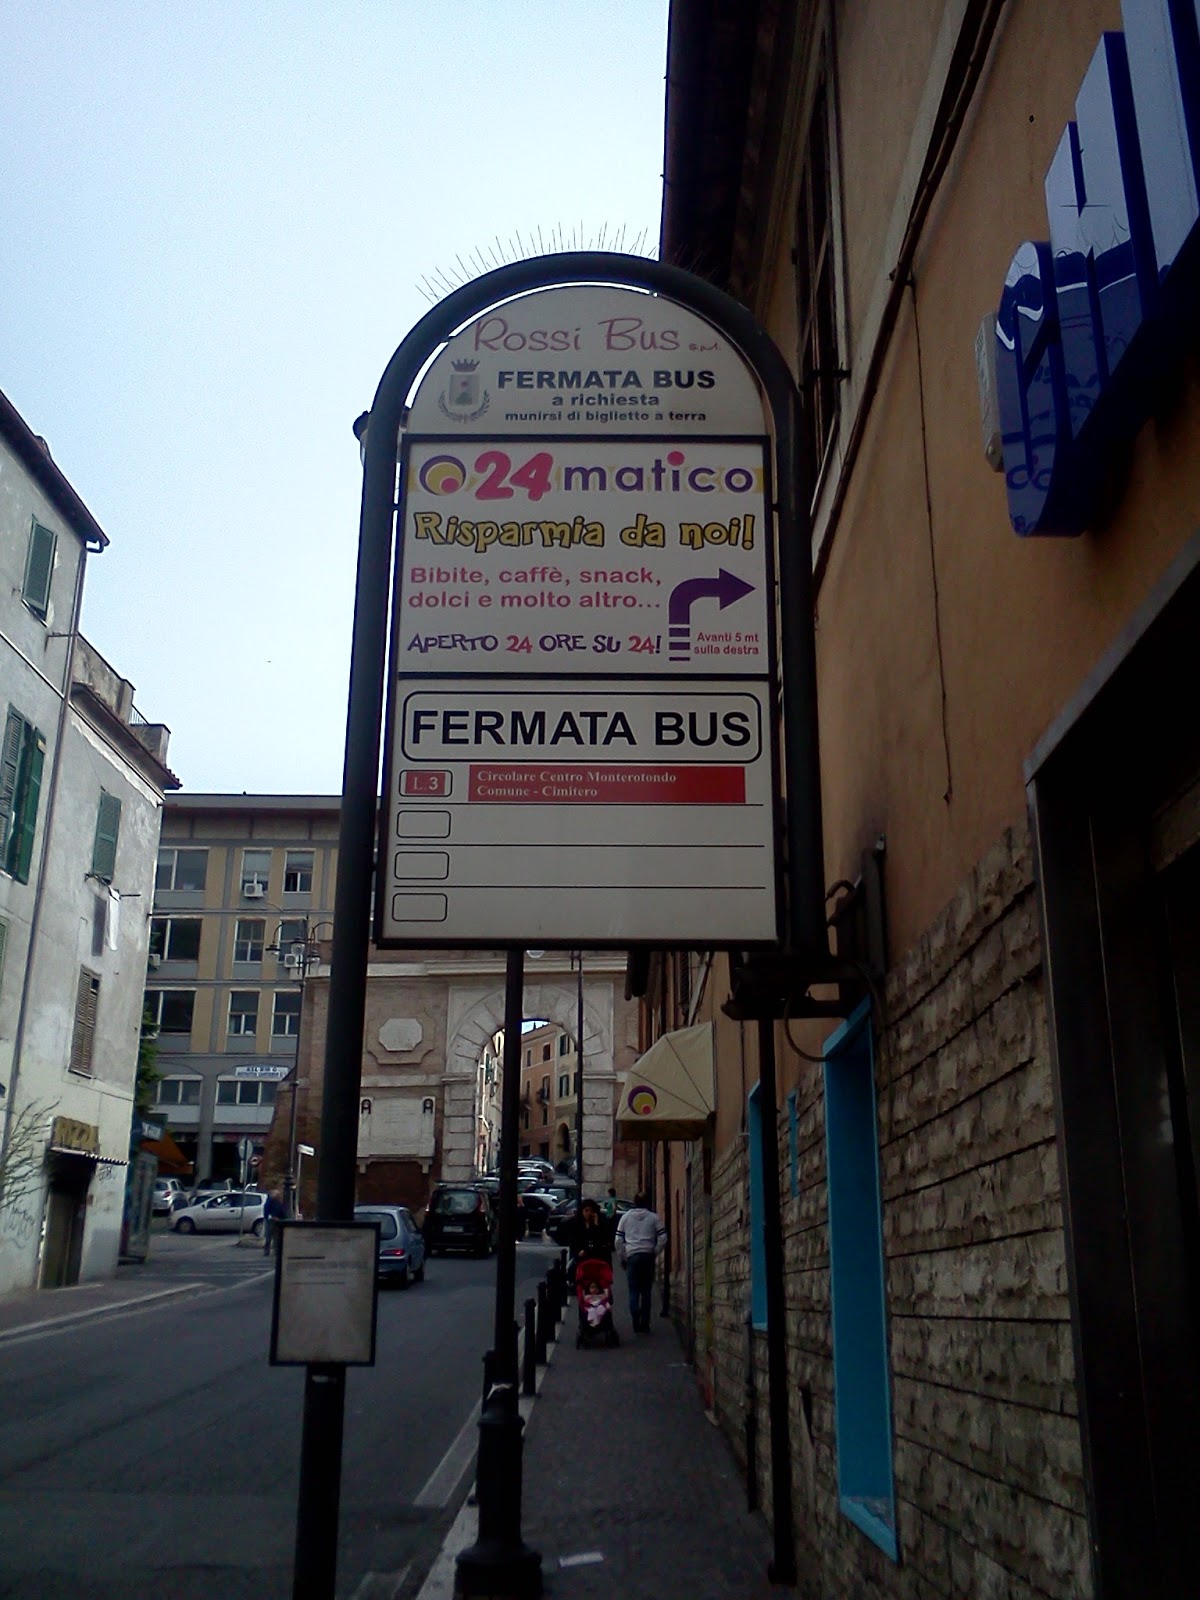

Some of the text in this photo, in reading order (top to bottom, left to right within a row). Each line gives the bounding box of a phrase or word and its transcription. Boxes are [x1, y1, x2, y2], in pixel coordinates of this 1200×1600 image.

[474, 317, 581, 351] Rossi
[598, 318, 680, 350] Bus
[499, 371, 715, 389] FERMATA BUS
[552, 393, 659, 406] a richiesta
[506, 411, 561, 420] munirsi
[567, 411, 580, 420] di
[586, 411, 649, 423] biglietto
[669, 412, 706, 420] terra
[413, 512, 755, 553] Risparmia da noi!
[411, 567, 661, 586] Bibite, caffè, snack,
[409, 591, 469, 607] dolci
[478, 595, 491, 607] e
[501, 591, 571, 607] molto
[407, 633, 661, 654] APERTO 24 ORE SU 24!
[697, 632, 758, 642] Avanti 5 mt
[694, 645, 758, 654] sulla destra
[413, 711, 750, 746] FERMATA BUS
[412, 776, 439, 791] L.3
[477, 769, 677, 783] Circolare Centro Monterotondo
[477, 785, 530, 797] Comune
[541, 785, 598, 797] Cimitero
